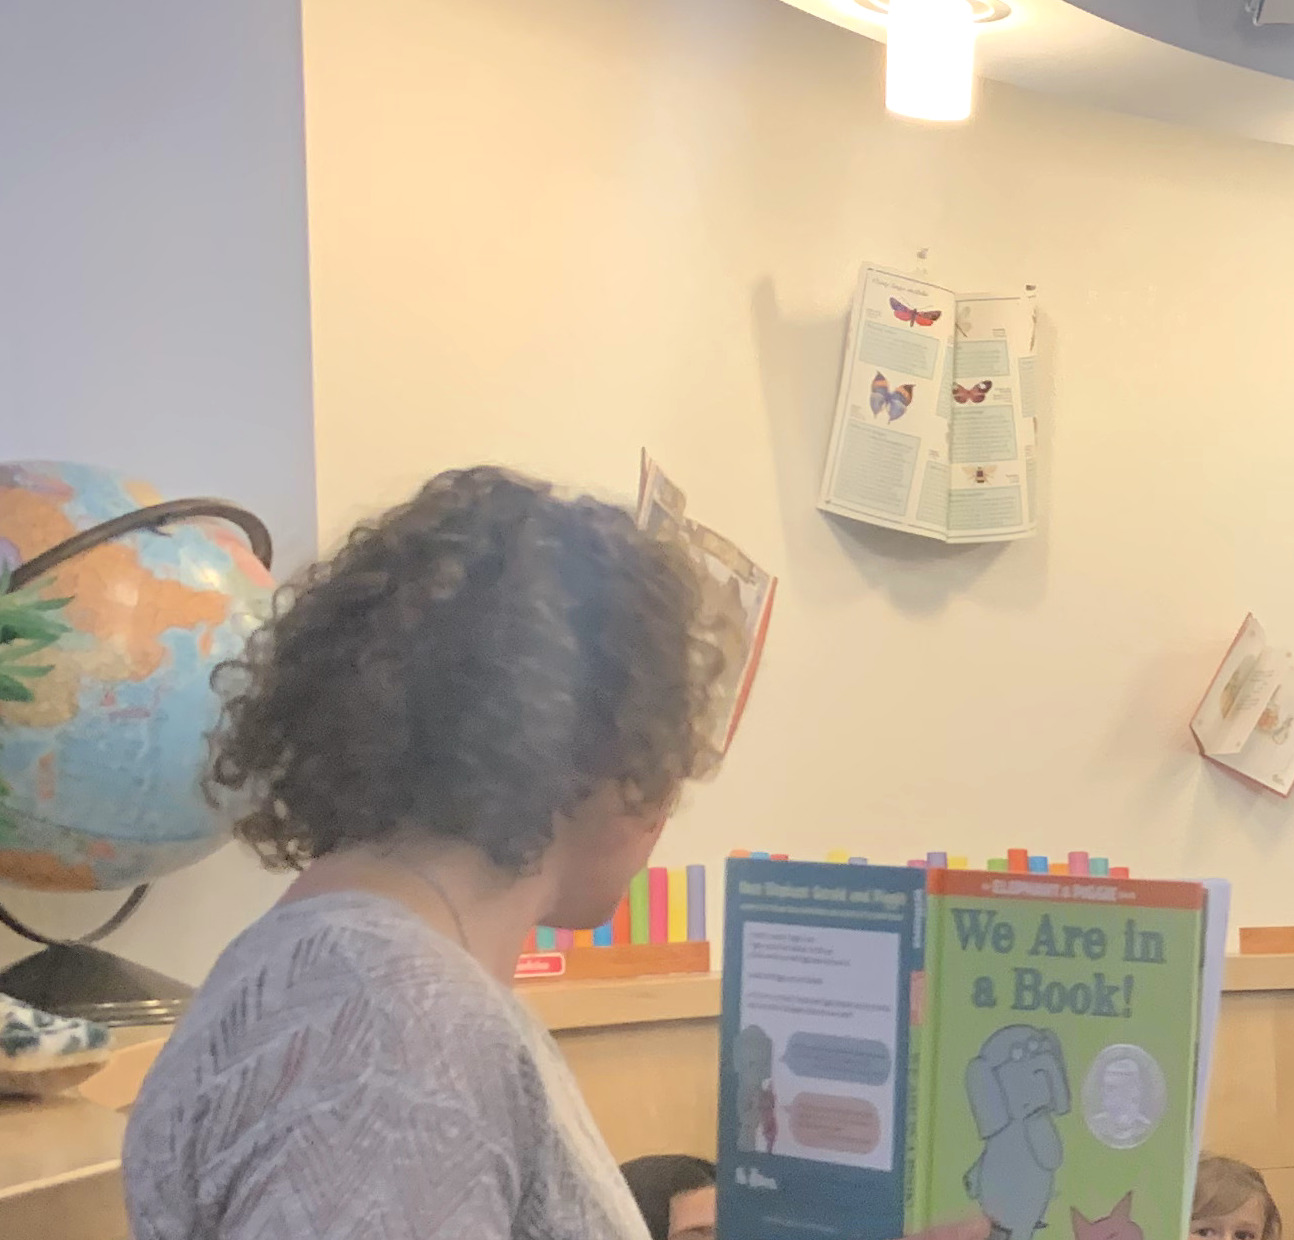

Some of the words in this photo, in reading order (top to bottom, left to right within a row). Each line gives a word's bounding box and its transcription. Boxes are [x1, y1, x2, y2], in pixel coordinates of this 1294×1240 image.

[952, 907, 1016, 954] We
[1027, 913, 1107, 960] Are
[1123, 919, 1167, 963] in
[971, 976, 996, 1008] a
[1011, 967, 1135, 1018] Book!
